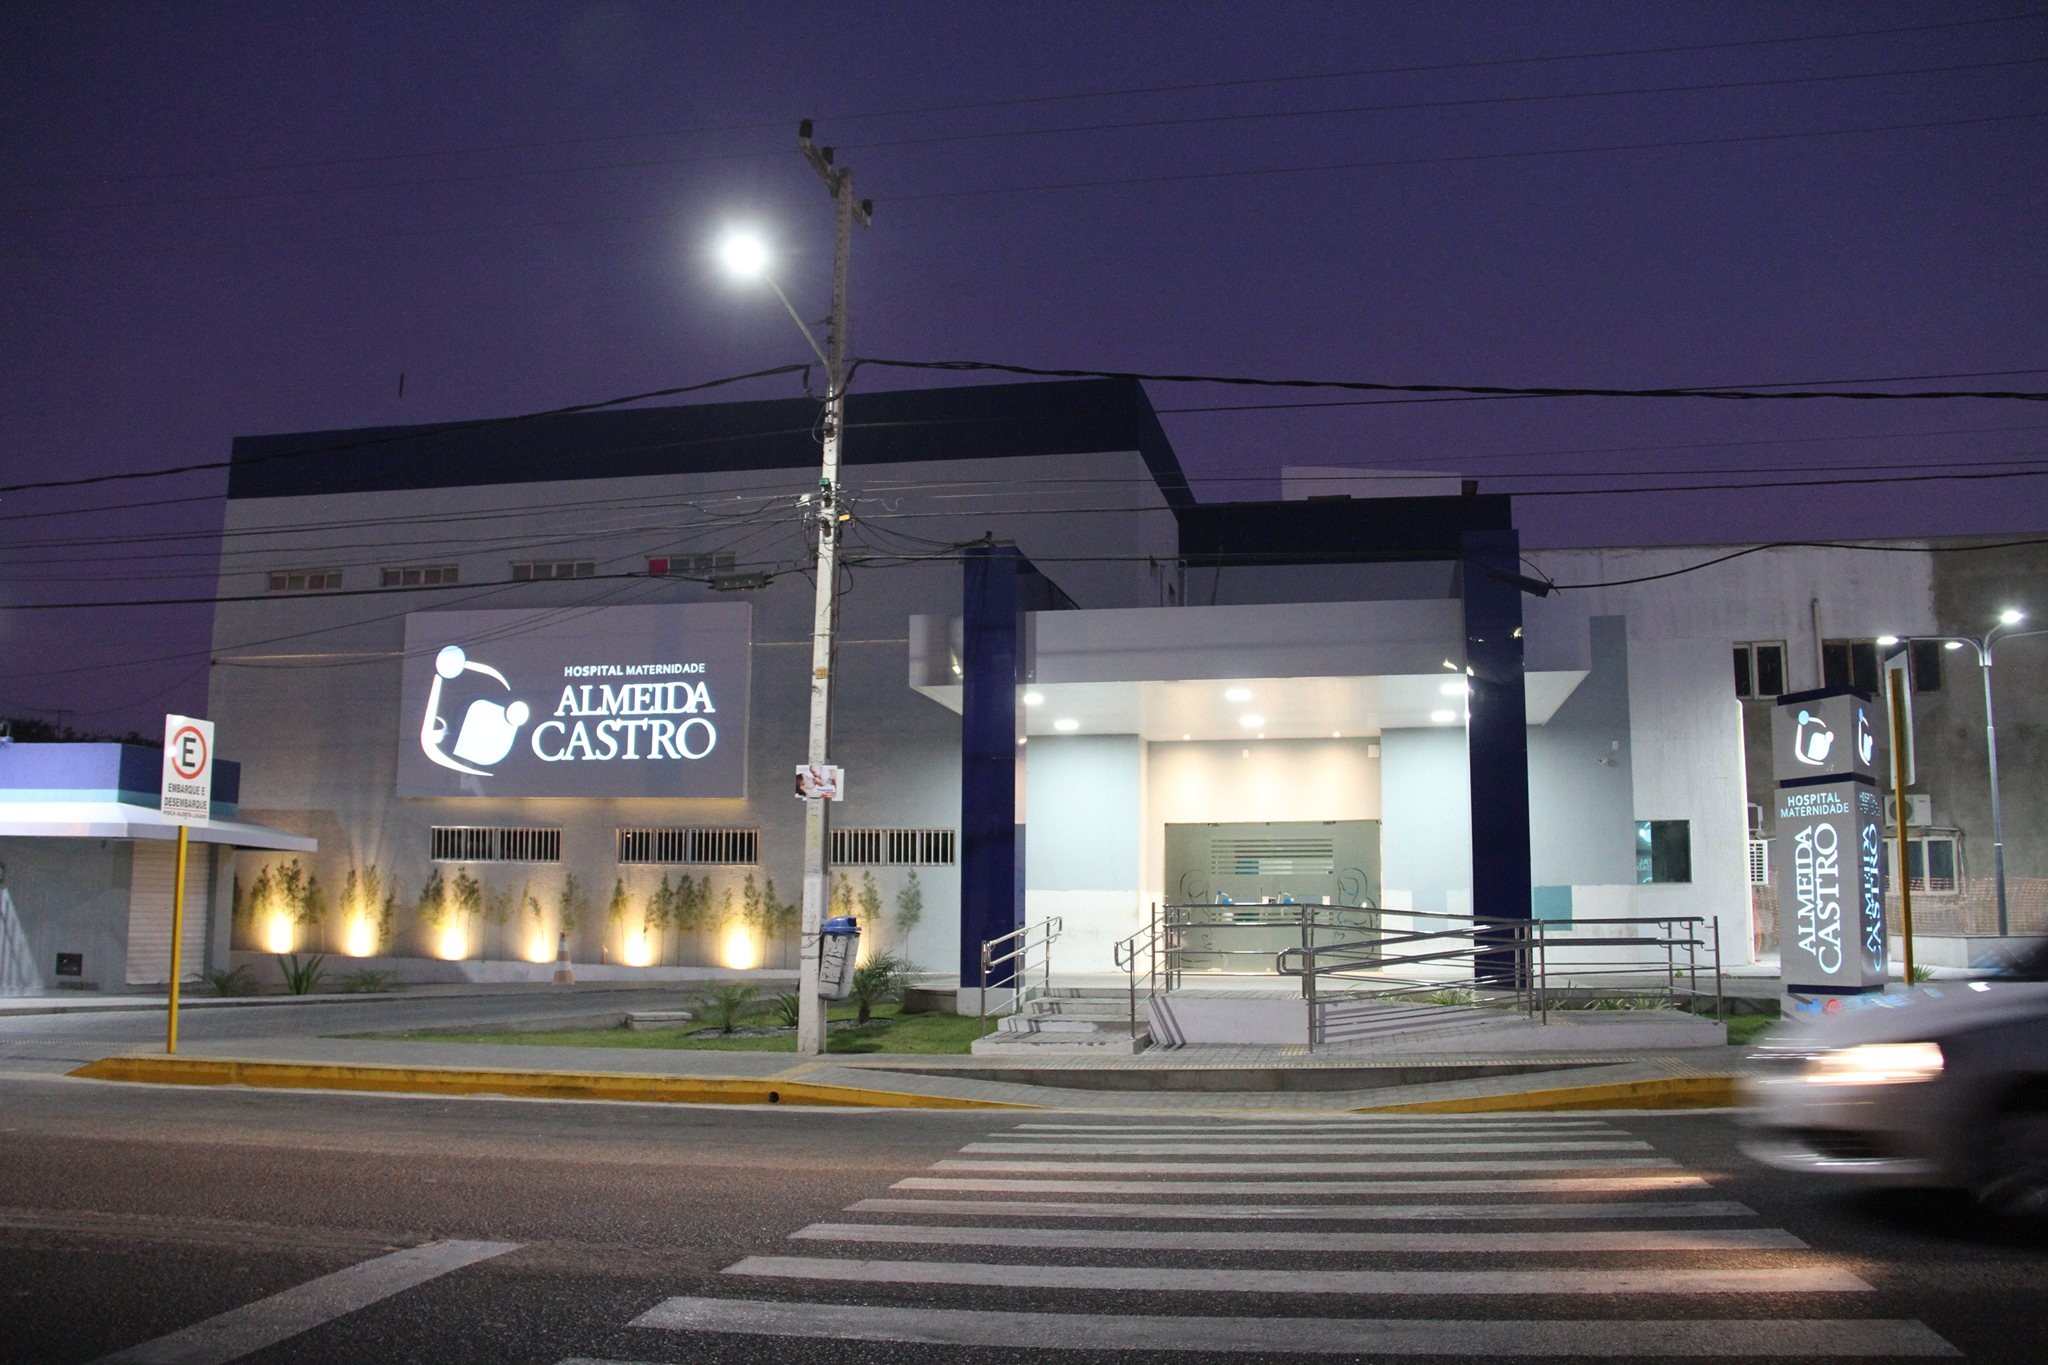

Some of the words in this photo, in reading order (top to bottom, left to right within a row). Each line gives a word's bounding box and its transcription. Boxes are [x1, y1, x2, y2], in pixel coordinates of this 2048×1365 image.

[564, 665, 624, 677] HOSPITAL
[626, 663, 706, 676] MATERNIDADE
[554, 681, 716, 716] ALMEIDA
[182, 736, 196, 768] E
[531, 718, 716, 762] CASTRO
[168, 783, 200, 795] EMBARQUE
[201, 786, 206, 796] E
[1787, 792, 1841, 807] HOSPITAL
[164, 797, 207, 810] DESEMBARQUE
[1780, 802, 1850, 818] MATERNIDADE
[1794, 825, 1817, 956] ALMEIDA
[1814, 822, 1842, 974] CASTRO
